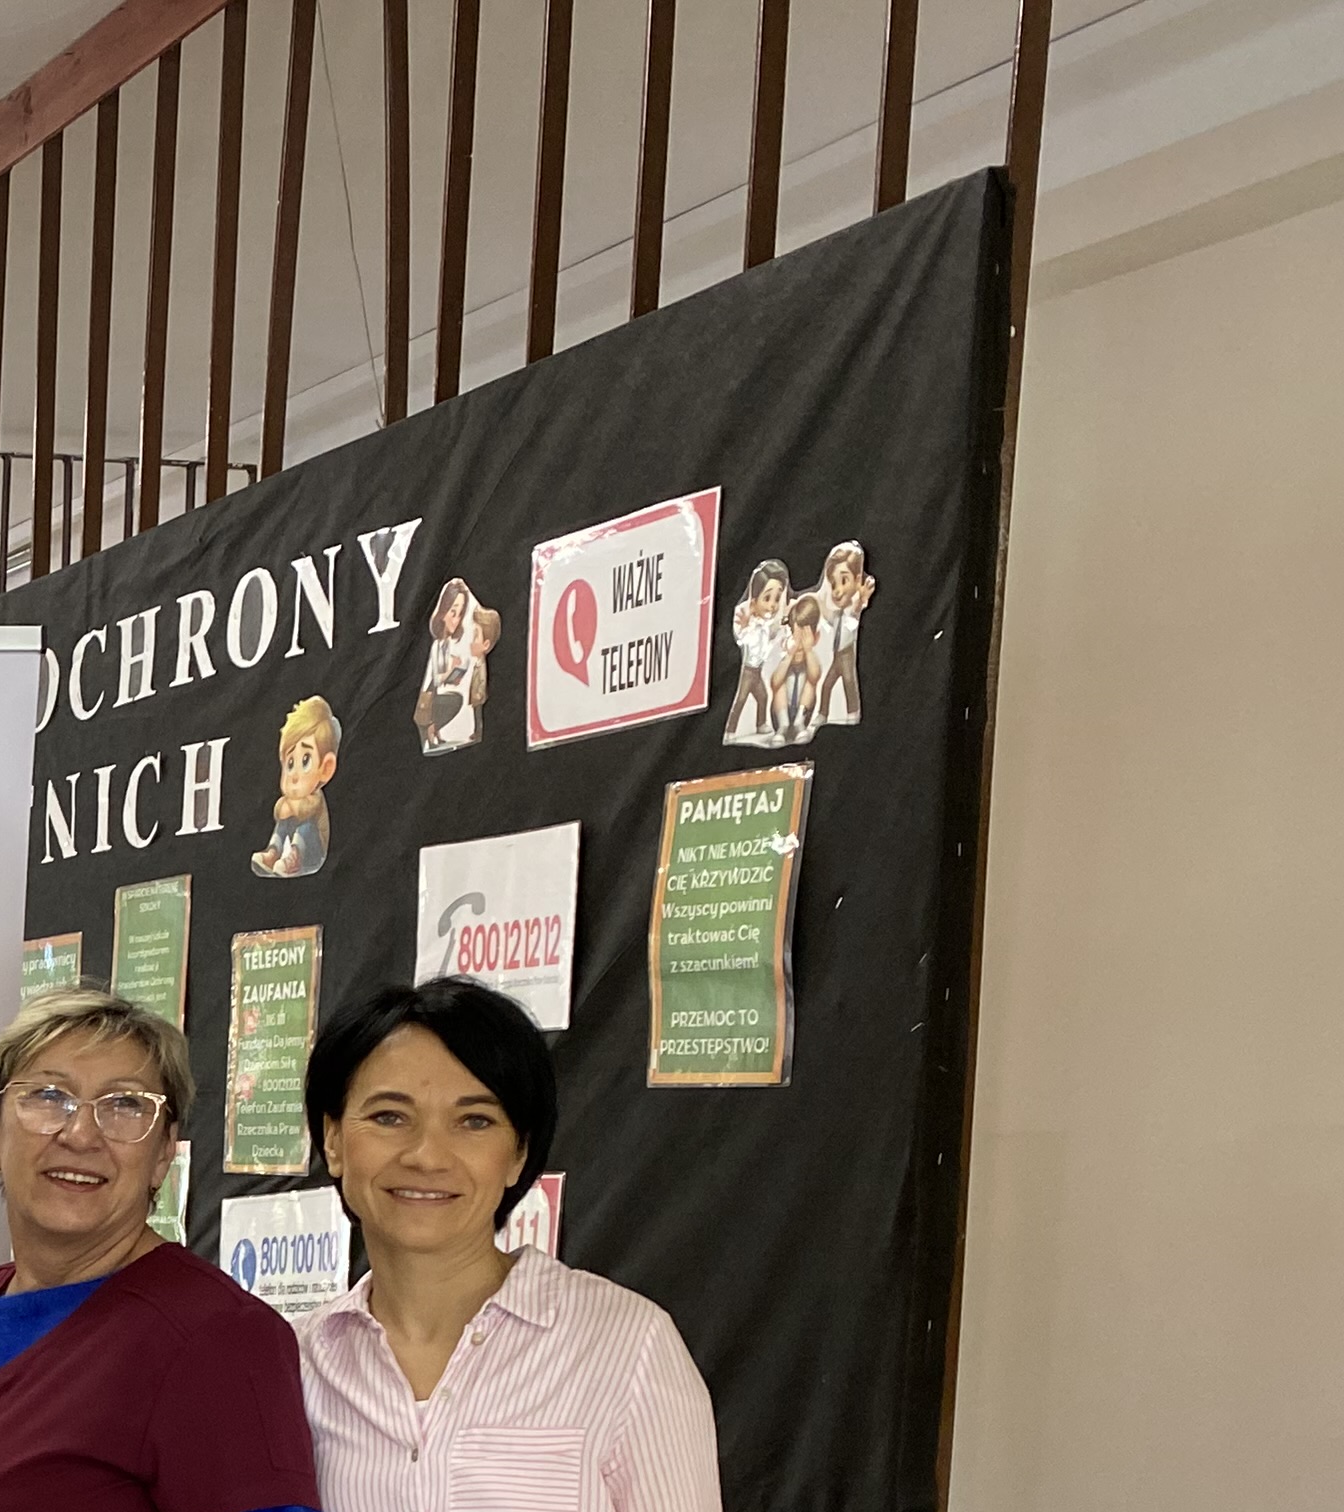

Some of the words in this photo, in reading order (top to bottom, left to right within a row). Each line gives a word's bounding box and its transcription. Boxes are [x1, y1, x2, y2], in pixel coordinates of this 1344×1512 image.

[612, 549, 664, 614] WAŻNE
[601, 630, 673, 694] TELEFONY
[32, 736, 231, 864] NICH
[679, 788, 784, 824] PAMIĘTAJ
[677, 845, 707, 864] NIKT
[707, 843, 728, 861] NIE
[729, 834, 771, 858] MOŻE
[667, 874, 688, 895] CIĘ
[691, 860, 774, 889] KRZYWDZIĆ
[661, 900, 719, 921] Wszyscy
[719, 894, 773, 919] powinni
[668, 927, 735, 945] traktować
[737, 924, 760, 943] Cię
[242, 945, 306, 970] TELEFONY
[670, 961, 678, 974] z
[679, 952, 759, 973] szacunkiem!
[242, 980, 306, 1004] ZAUFANIA
[671, 1010, 736, 1028] PRZEMOC
[738, 1008, 759, 1025] TO
[660, 1037, 770, 1060] PRZESTĘPSTWO!
[236, 1101, 266, 1114] Telefon
[252, 1144, 284, 1158] Dziecka
[260, 1236, 288, 1276] 800
[290, 1233, 315, 1275] 100
[317, 1231, 339, 1272] 100
